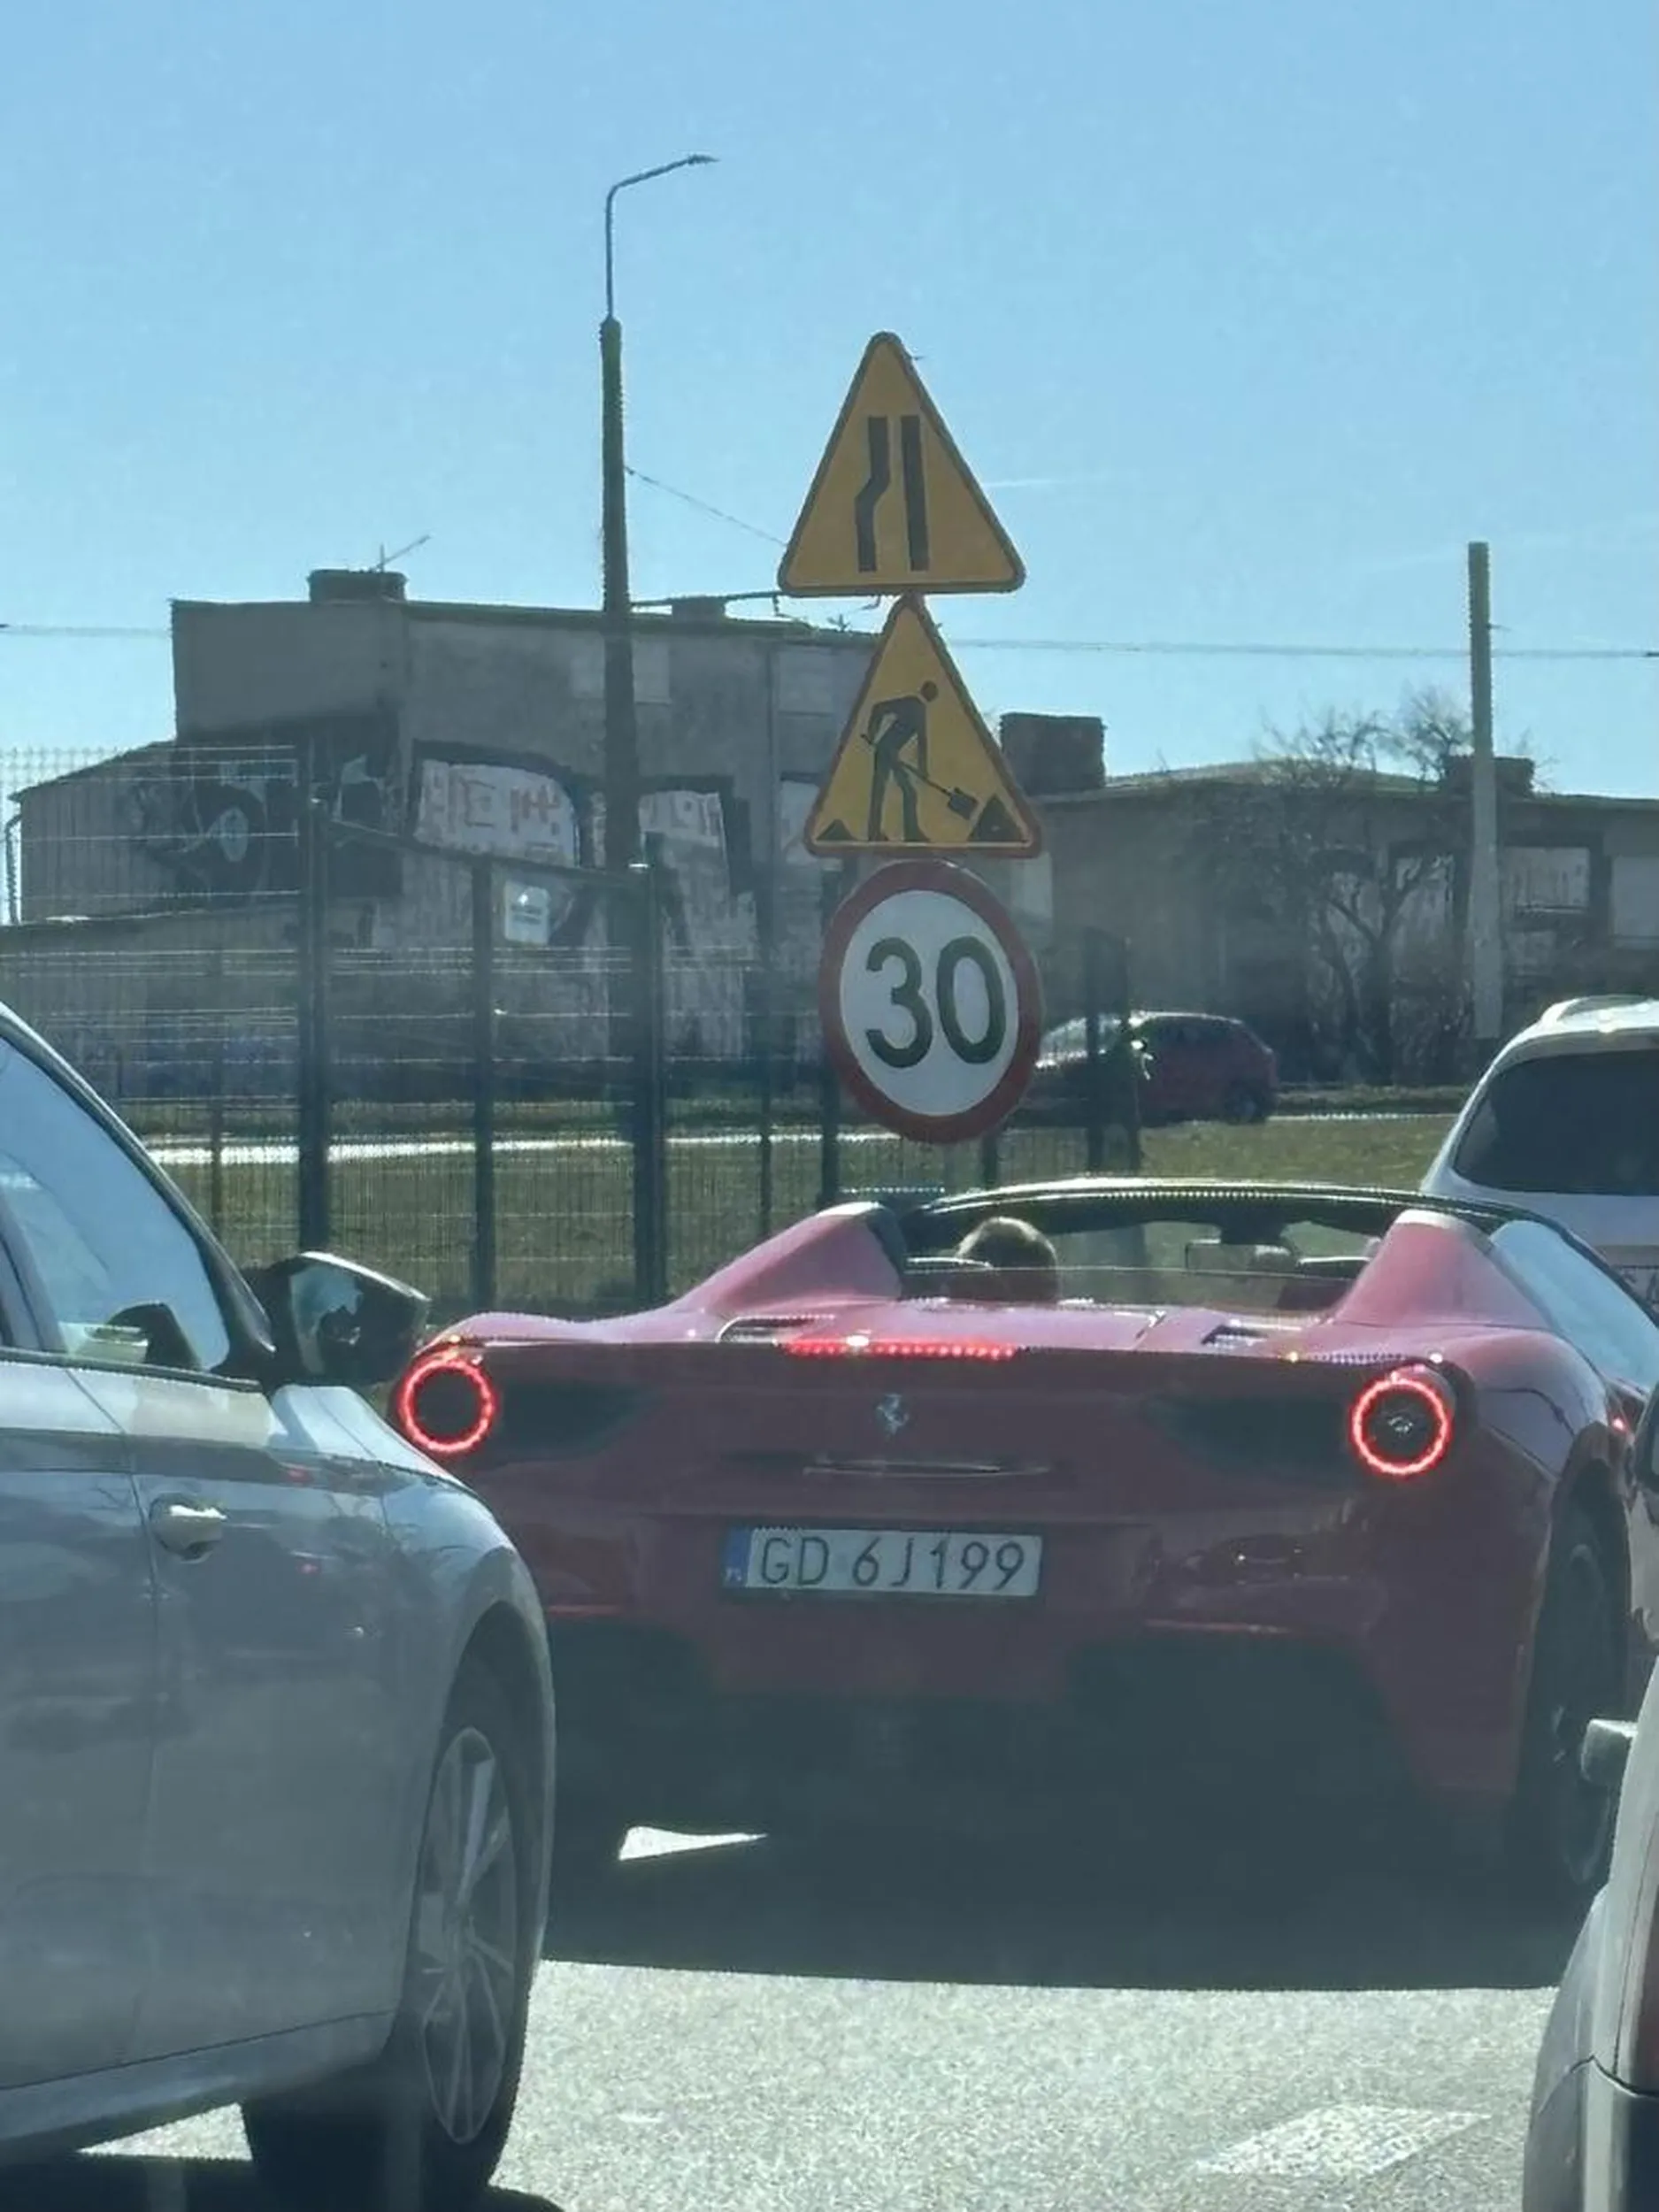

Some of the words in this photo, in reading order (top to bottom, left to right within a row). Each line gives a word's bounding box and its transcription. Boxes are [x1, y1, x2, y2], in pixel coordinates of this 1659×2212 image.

[865, 935, 1006, 1068] 30
[760, 1536, 830, 1586] GD
[852, 1536, 1025, 1590] 6J199
